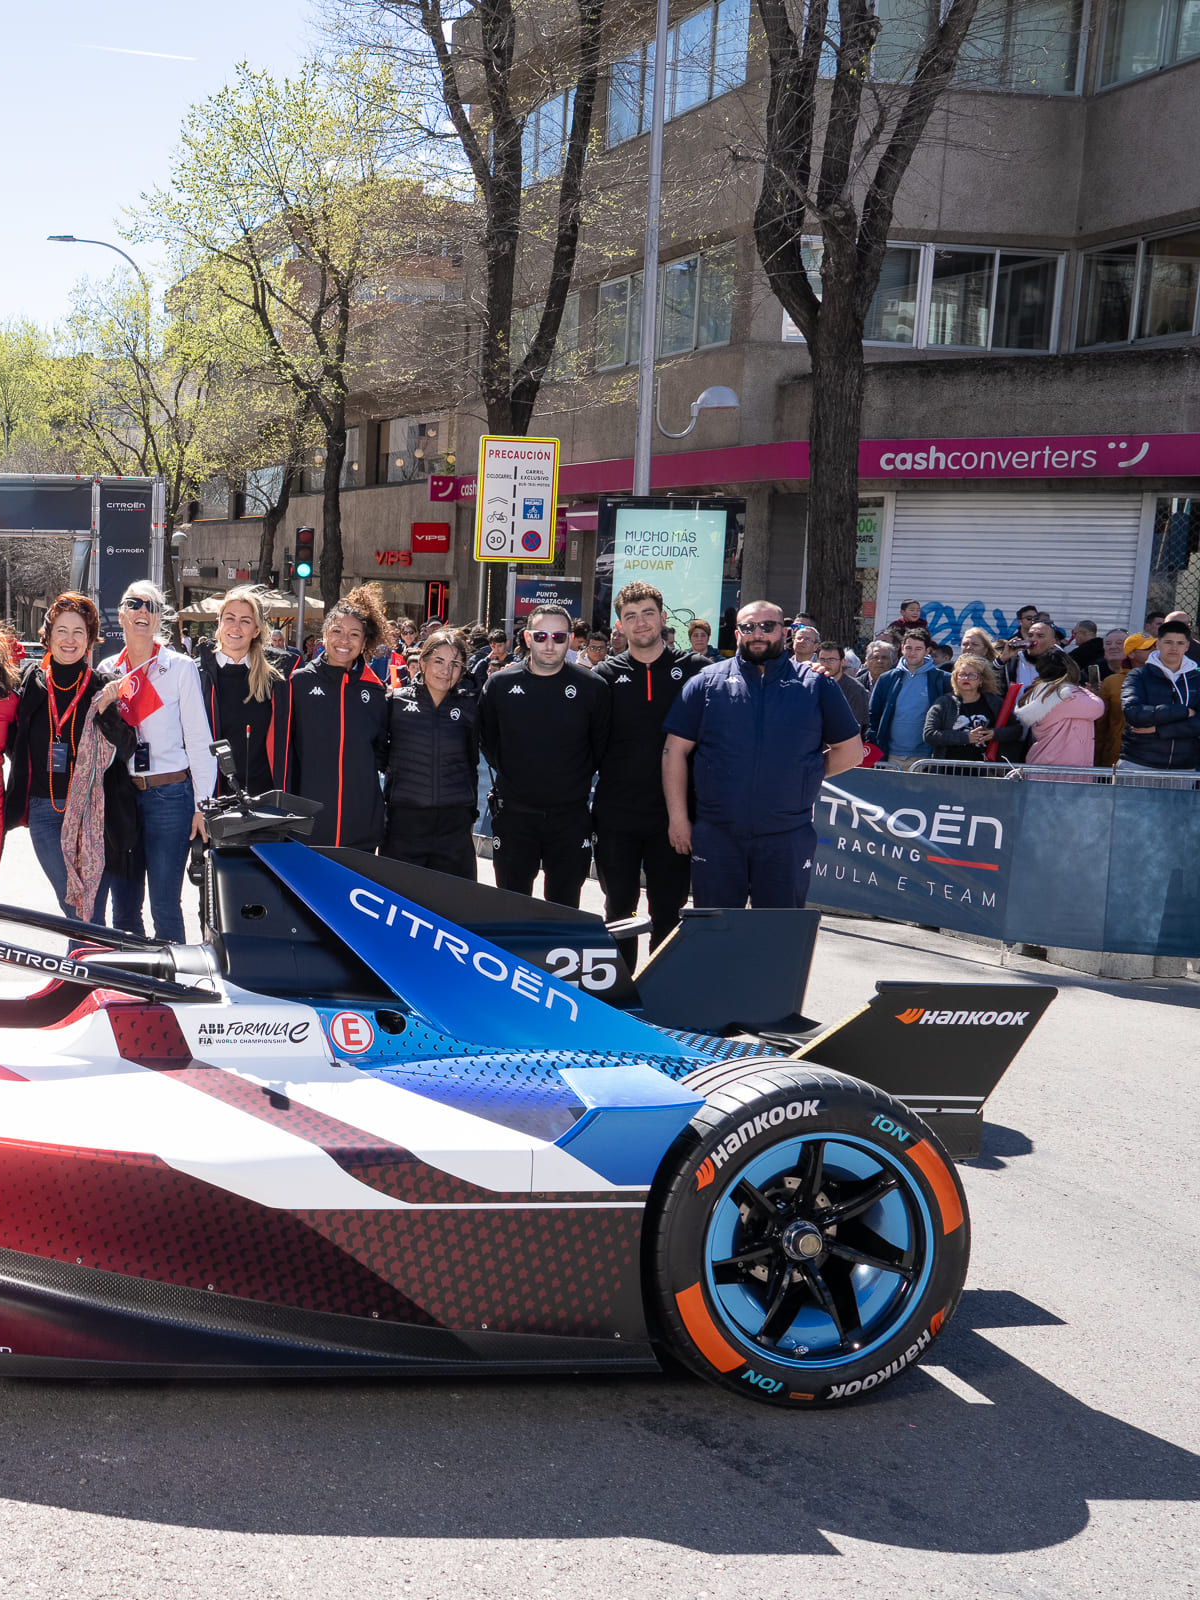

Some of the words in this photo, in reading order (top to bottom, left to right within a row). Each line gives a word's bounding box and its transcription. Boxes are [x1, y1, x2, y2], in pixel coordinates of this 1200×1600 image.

[488, 449, 551, 461] PRECAUCIÓN
[490, 536, 502, 544] 30
[625, 530, 669, 542] MUCHO
[671, 529, 697, 543] MÁS
[374, 551, 412, 566] VIPS
[624, 545, 650, 557] QUE
[652, 545, 700, 558] CUIDAR.
[530, 597, 573, 605] HIDRATACIÓN
[837, 836, 922, 862] RACING
[815, 862, 878, 886] MULA
[897, 876, 908, 892] E
[927, 881, 997, 908] TEAM
[349, 887, 580, 1023] CITROËN
[545, 948, 618, 991] 25
[198, 1023, 224, 1034] ABB
[226, 1022, 290, 1036] FORMULA
[341, 1018, 363, 1046] E
